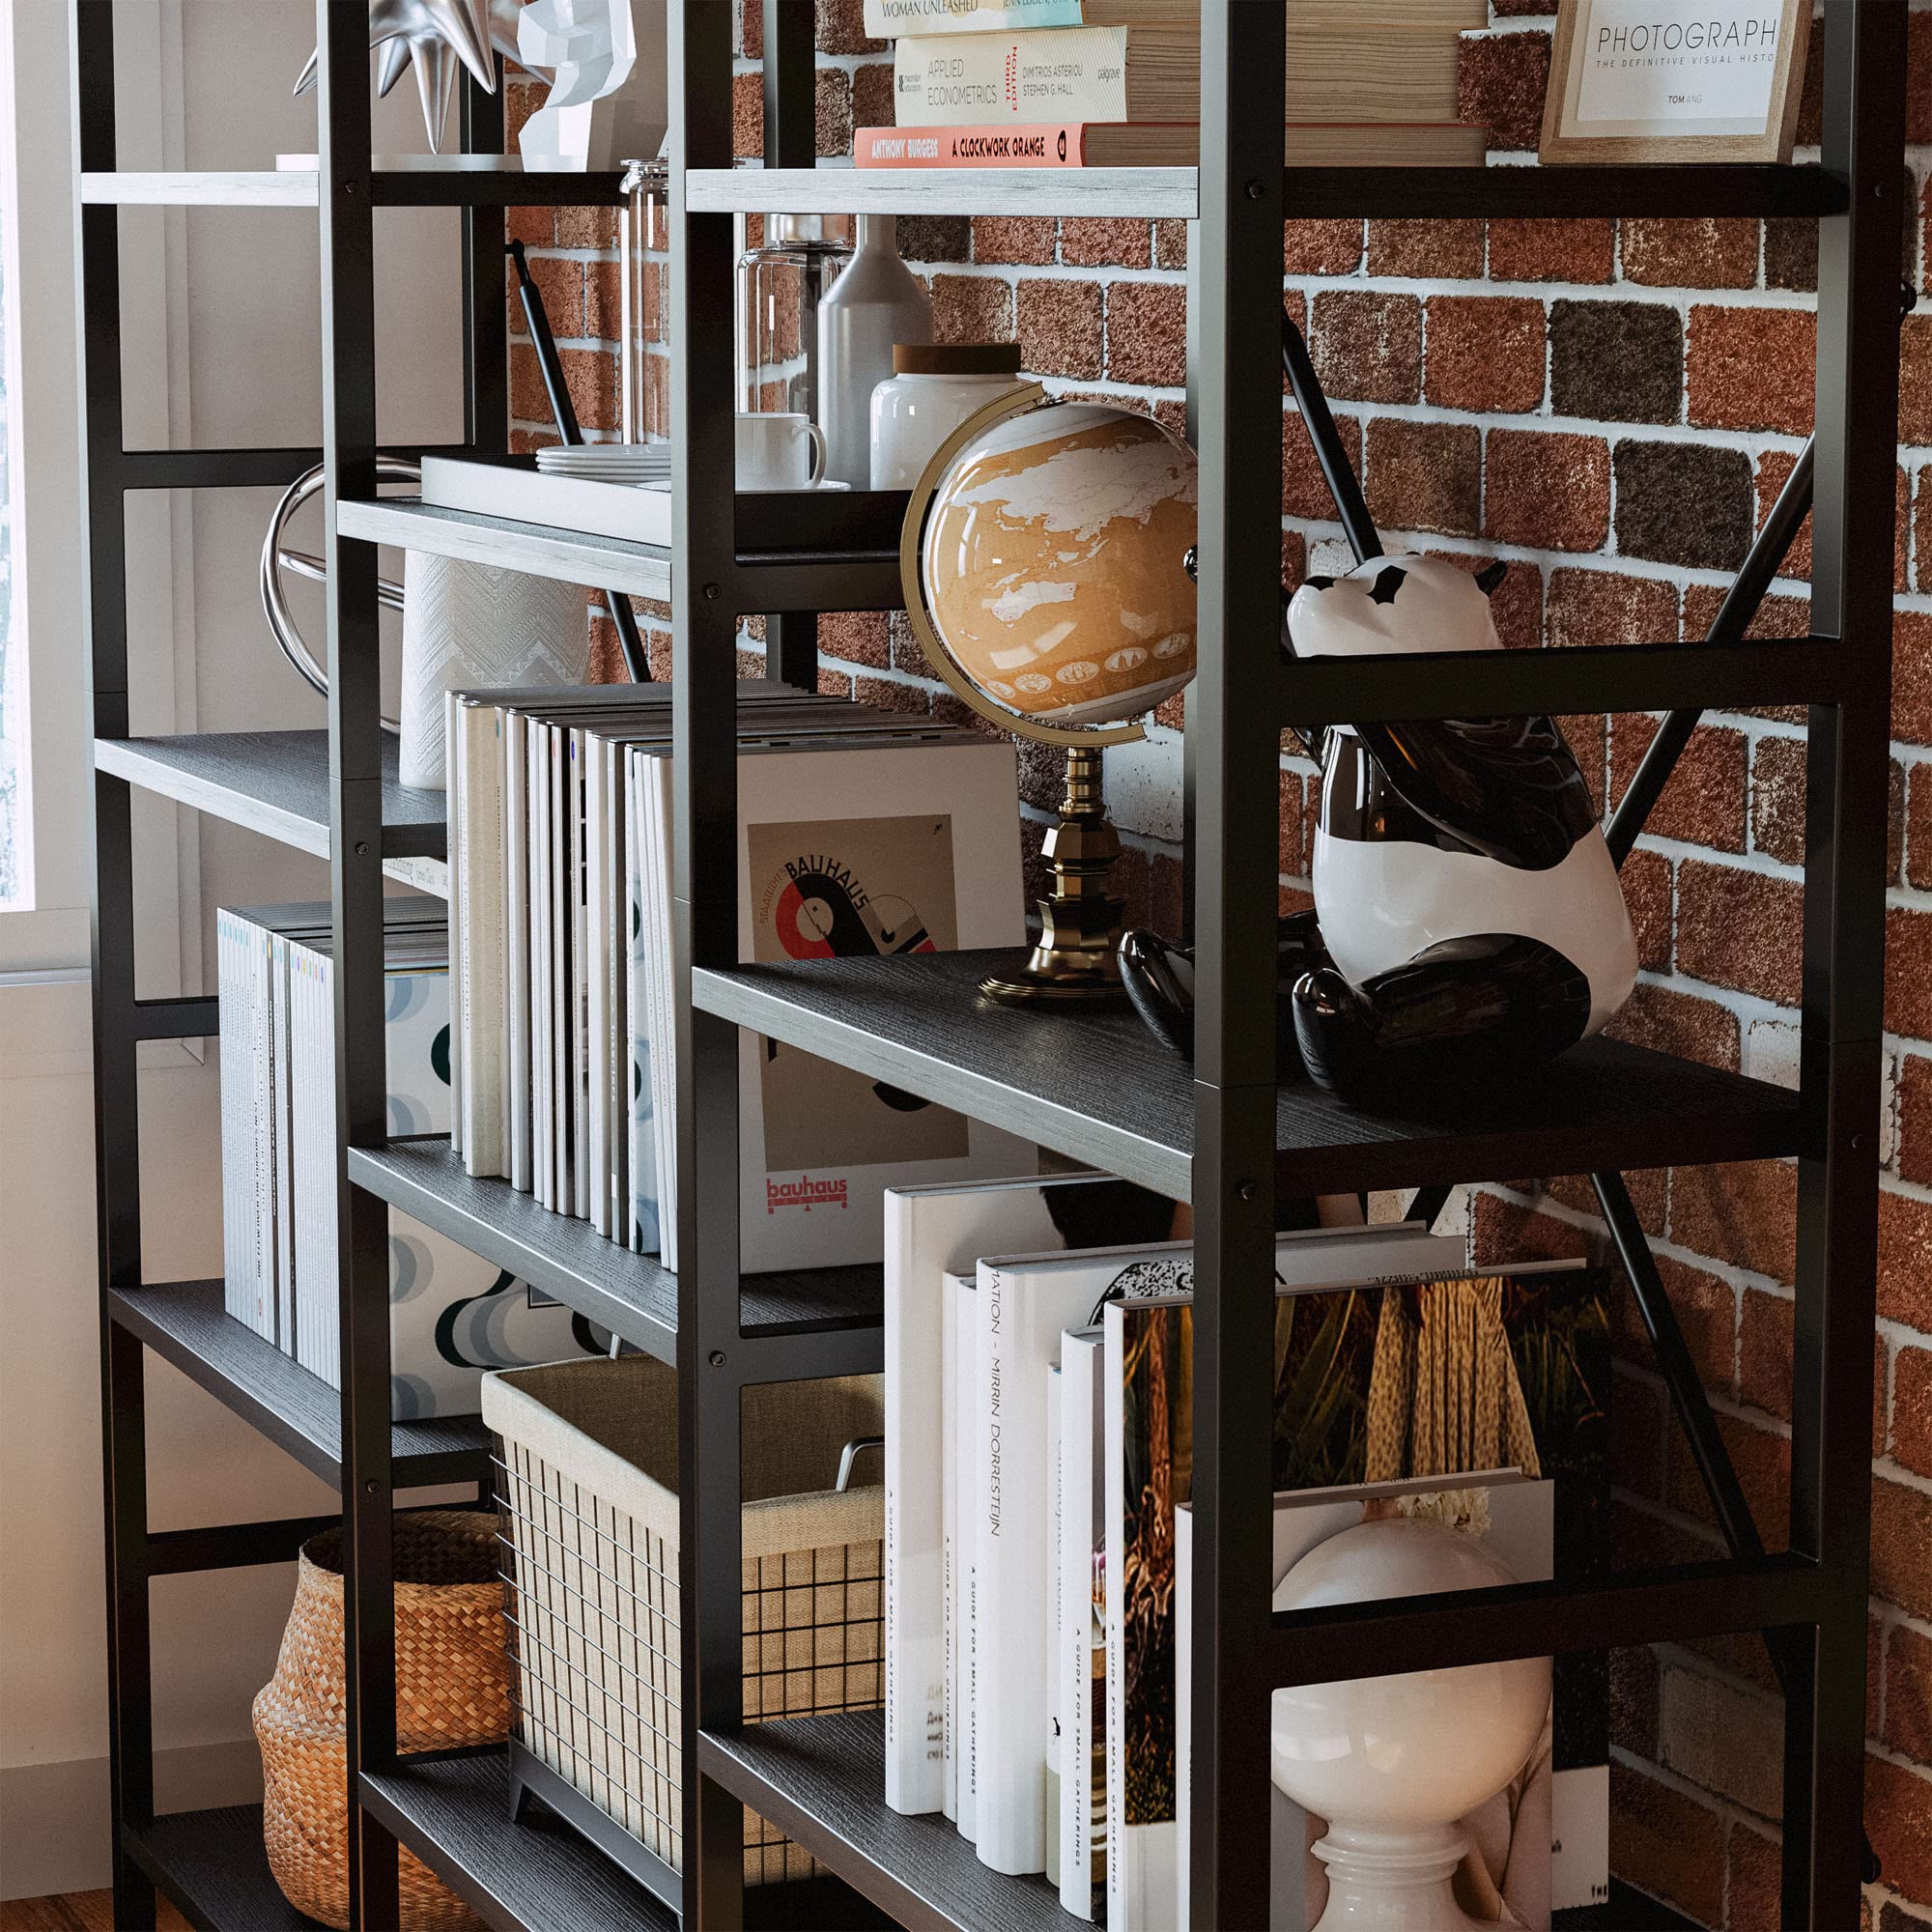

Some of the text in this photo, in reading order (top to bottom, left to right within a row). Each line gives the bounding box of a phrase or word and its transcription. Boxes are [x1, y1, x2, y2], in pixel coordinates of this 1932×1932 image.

[882, 0, 979, 17] WOMAN UNLEASHED
[1598, 18, 1776, 52] PHOTOGRAPH
[927, 58, 964, 77] APPLIED
[1022, 64, 1083, 78] DIMITRIOS ASTERIOU
[1596, 53, 1774, 69] THE DEFINITIVE VISUAL HISTO
[1097, 68, 1121, 82] palgrave
[927, 84, 998, 105] ECONOMETRICS
[1022, 83, 1049, 96] STEPHEN
[1057, 83, 1073, 95] HALL
[1668, 94, 1703, 104] TOM ANG
[871, 138, 939, 159] ANTHONY BURGESS
[952, 136, 1045, 158] A CLOCKWORK ORANGE
[784, 854, 869, 911] BAUHAUS
[766, 1175, 847, 1198] bauhaus
[990, 1356, 1001, 1417] MIRRIN
[989, 1423, 1001, 1537] DORRESTEIJN
